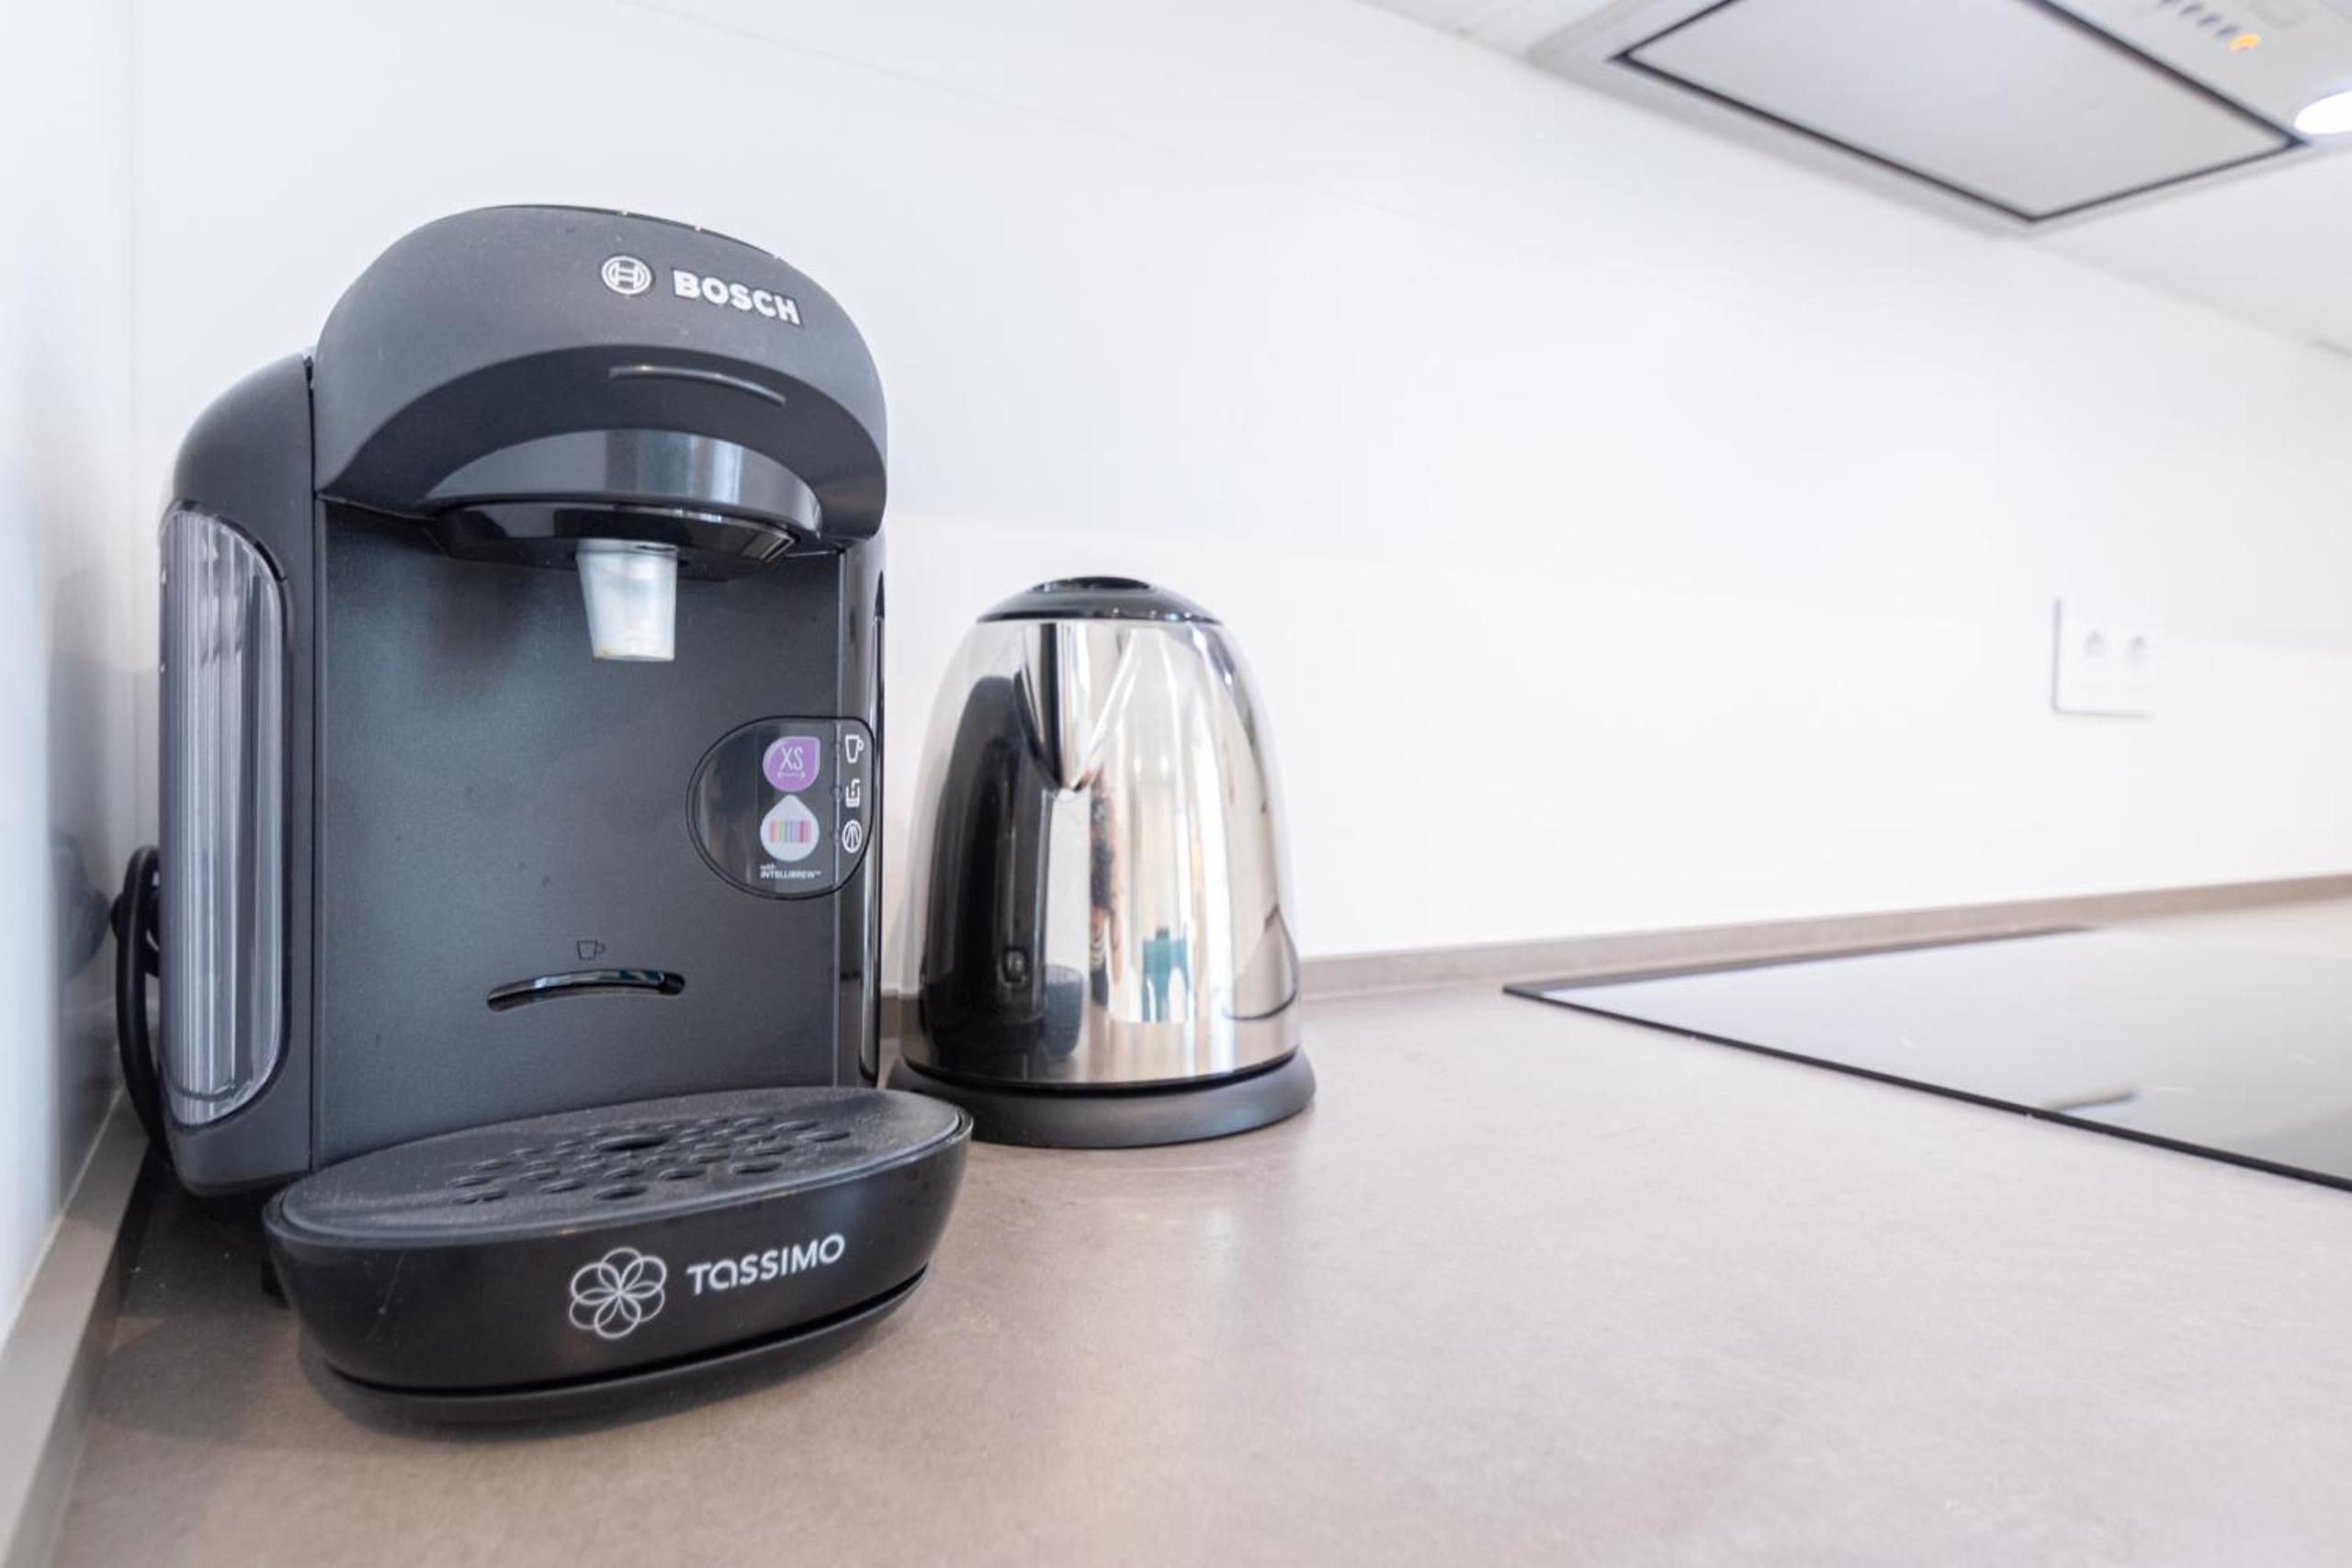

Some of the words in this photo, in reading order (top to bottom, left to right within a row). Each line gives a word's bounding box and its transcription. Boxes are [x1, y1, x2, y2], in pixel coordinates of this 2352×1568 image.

[673, 270, 800, 324] BOSCH
[780, 746, 804, 770] XS
[686, 1233, 845, 1295] TASSIMO
